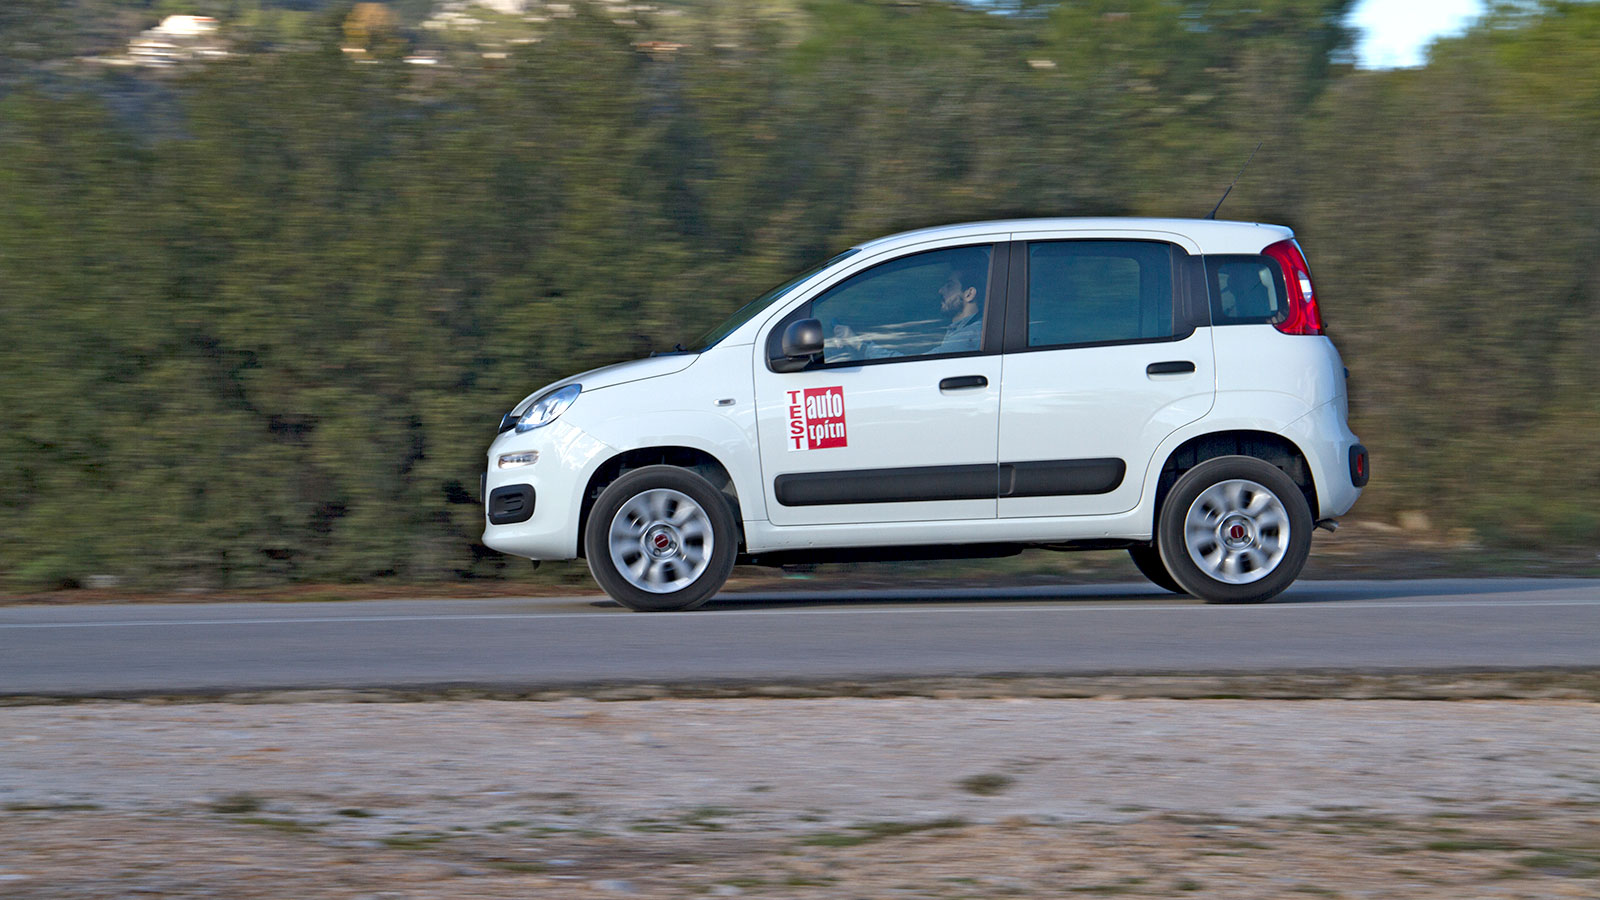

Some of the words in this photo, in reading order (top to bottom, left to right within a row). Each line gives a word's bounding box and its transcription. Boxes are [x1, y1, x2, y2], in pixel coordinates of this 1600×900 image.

[806, 389, 843, 419] auto
[787, 390, 804, 449] TEST
[808, 420, 845, 446] τρίτη
